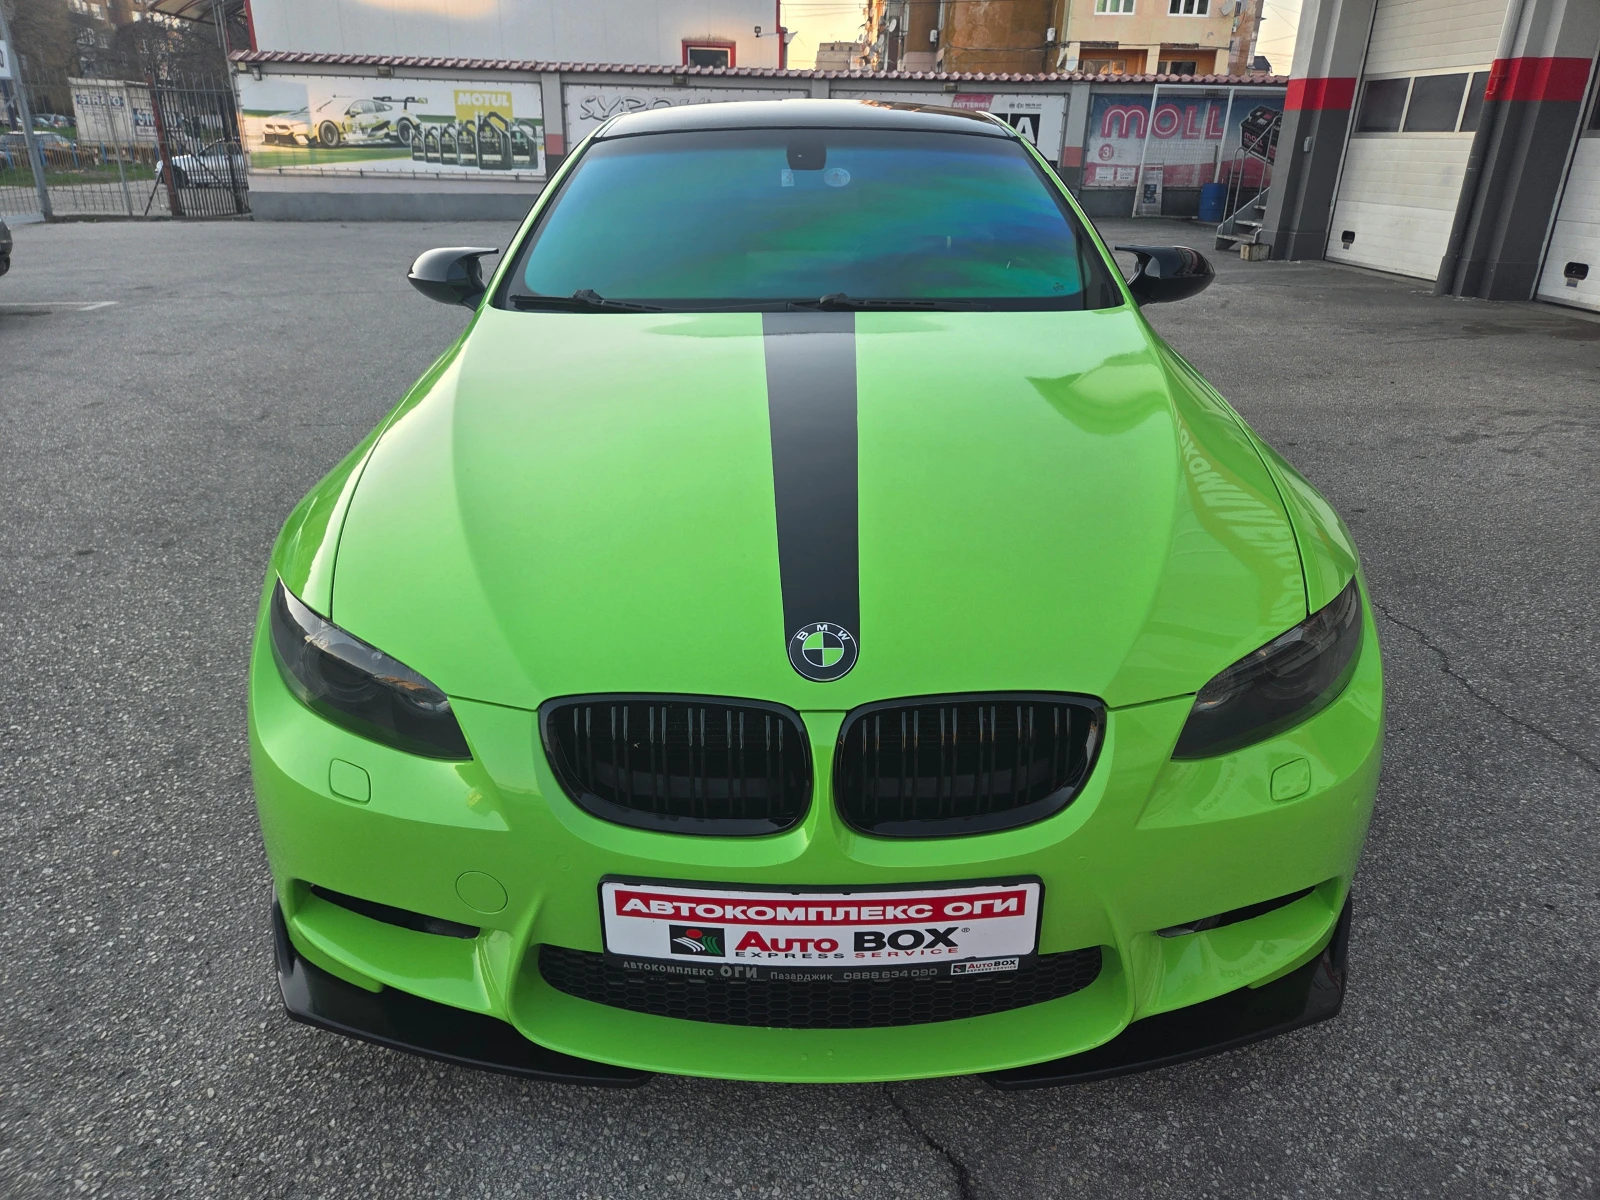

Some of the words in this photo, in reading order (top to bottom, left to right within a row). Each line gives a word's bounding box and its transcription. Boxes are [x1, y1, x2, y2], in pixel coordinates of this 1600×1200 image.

[457, 91, 510, 107] MOTUL
[953, 101, 990, 109] BATTERIES
[796, 624, 851, 641] BMW
[621, 898, 934, 921] АВТОКОМПЛЕКС
[943, 897, 1018, 916] ОГИ
[735, 951, 845, 959] EXPRESS
[854, 947, 959, 959] SERVICE
[623, 960, 715, 977] АВТОКОМПЛЕКС
[720, 964, 758, 979] ОГИ
[770, 971, 833, 982] Пазарджик
